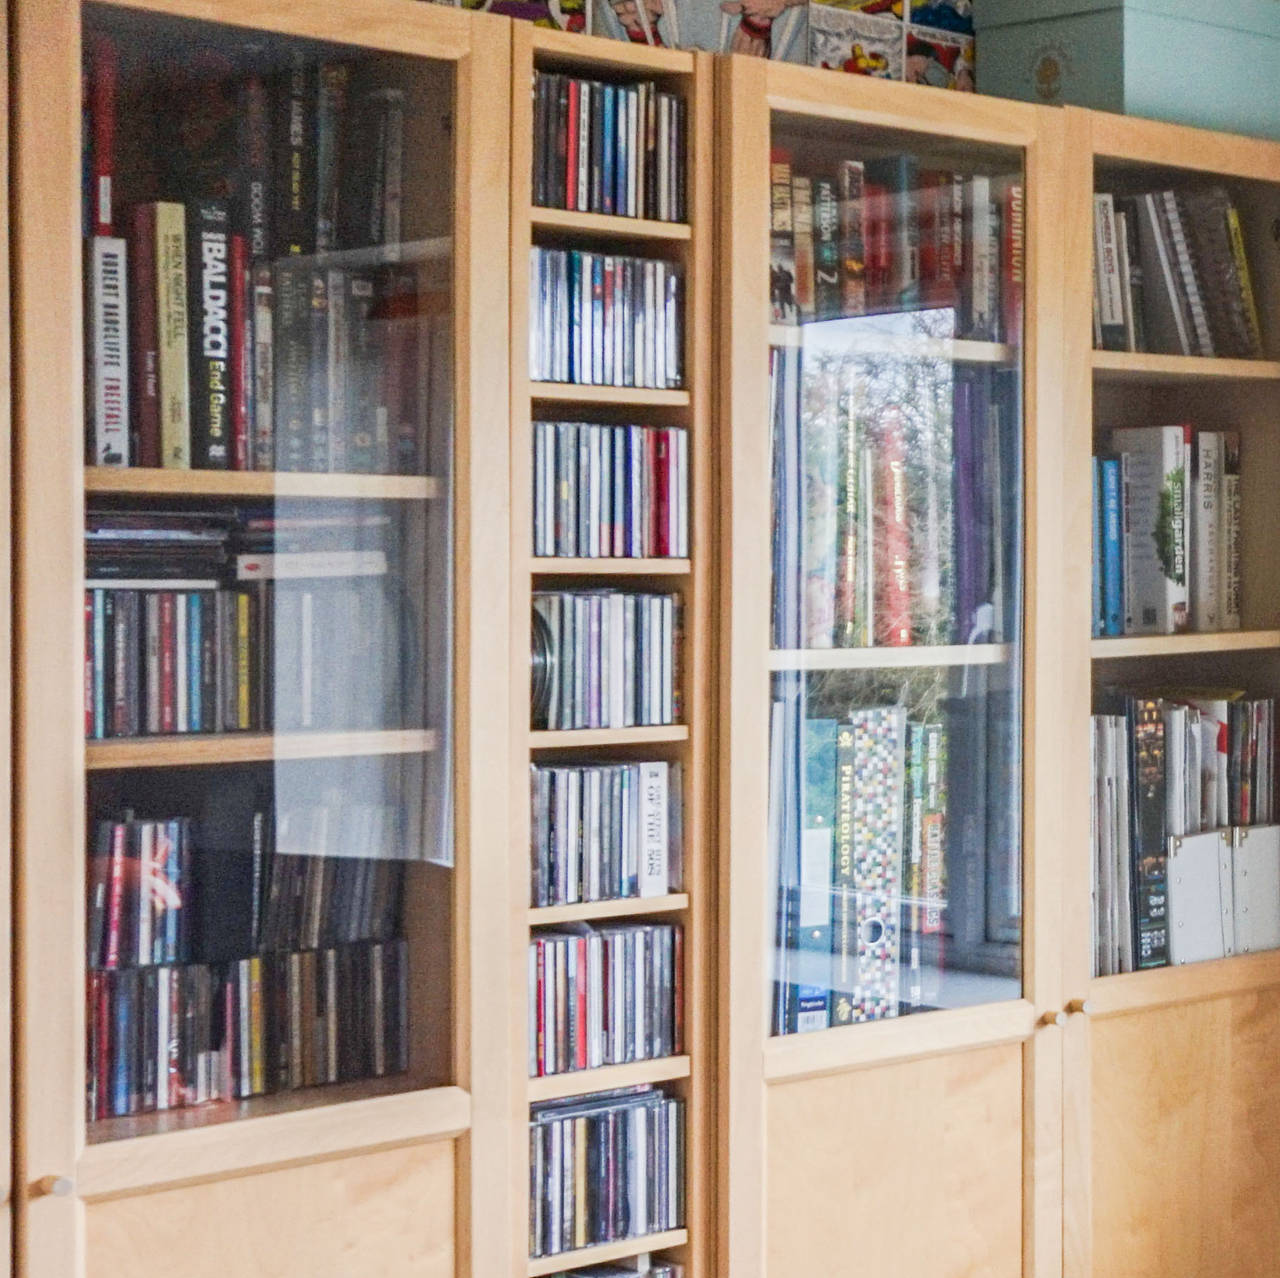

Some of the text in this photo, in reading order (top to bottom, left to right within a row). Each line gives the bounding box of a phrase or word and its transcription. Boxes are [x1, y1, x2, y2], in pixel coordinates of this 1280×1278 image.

[819, 183, 832, 241] PATTERSON
[202, 241, 228, 358] BALDACCI
[102, 252, 121, 434] ROBERT RADCLIFFE FREEFALL
[209, 361, 224, 390] End
[209, 393, 225, 438] Game
[1202, 448, 1214, 511] HARRIS
[1171, 482, 1184, 574] smallgarden
[839, 764, 852, 877] PIRATEOLOGY
